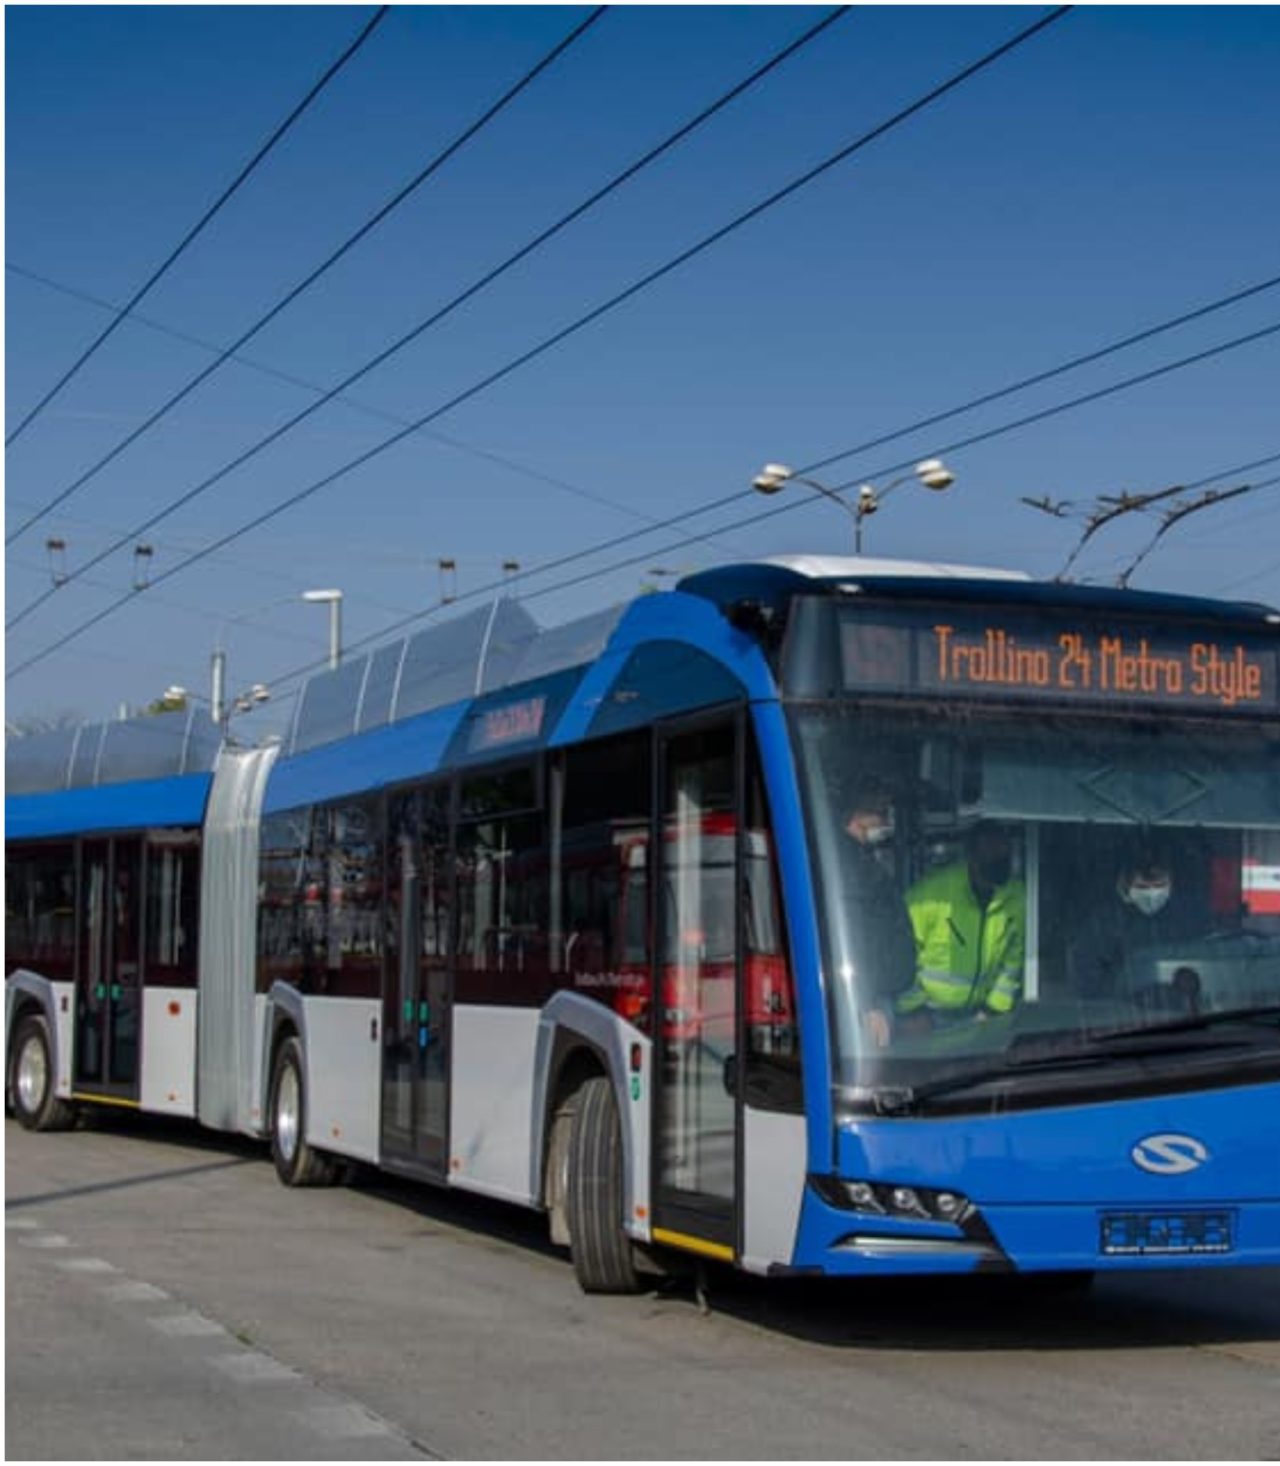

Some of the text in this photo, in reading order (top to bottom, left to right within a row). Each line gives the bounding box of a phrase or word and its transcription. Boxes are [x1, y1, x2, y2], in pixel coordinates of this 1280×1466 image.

[933, 624, 1049, 684] Trollino
[1058, 632, 1090, 688] 24
[1099, 636, 1182, 694] Metro
[1190, 643, 1262, 706] Style
